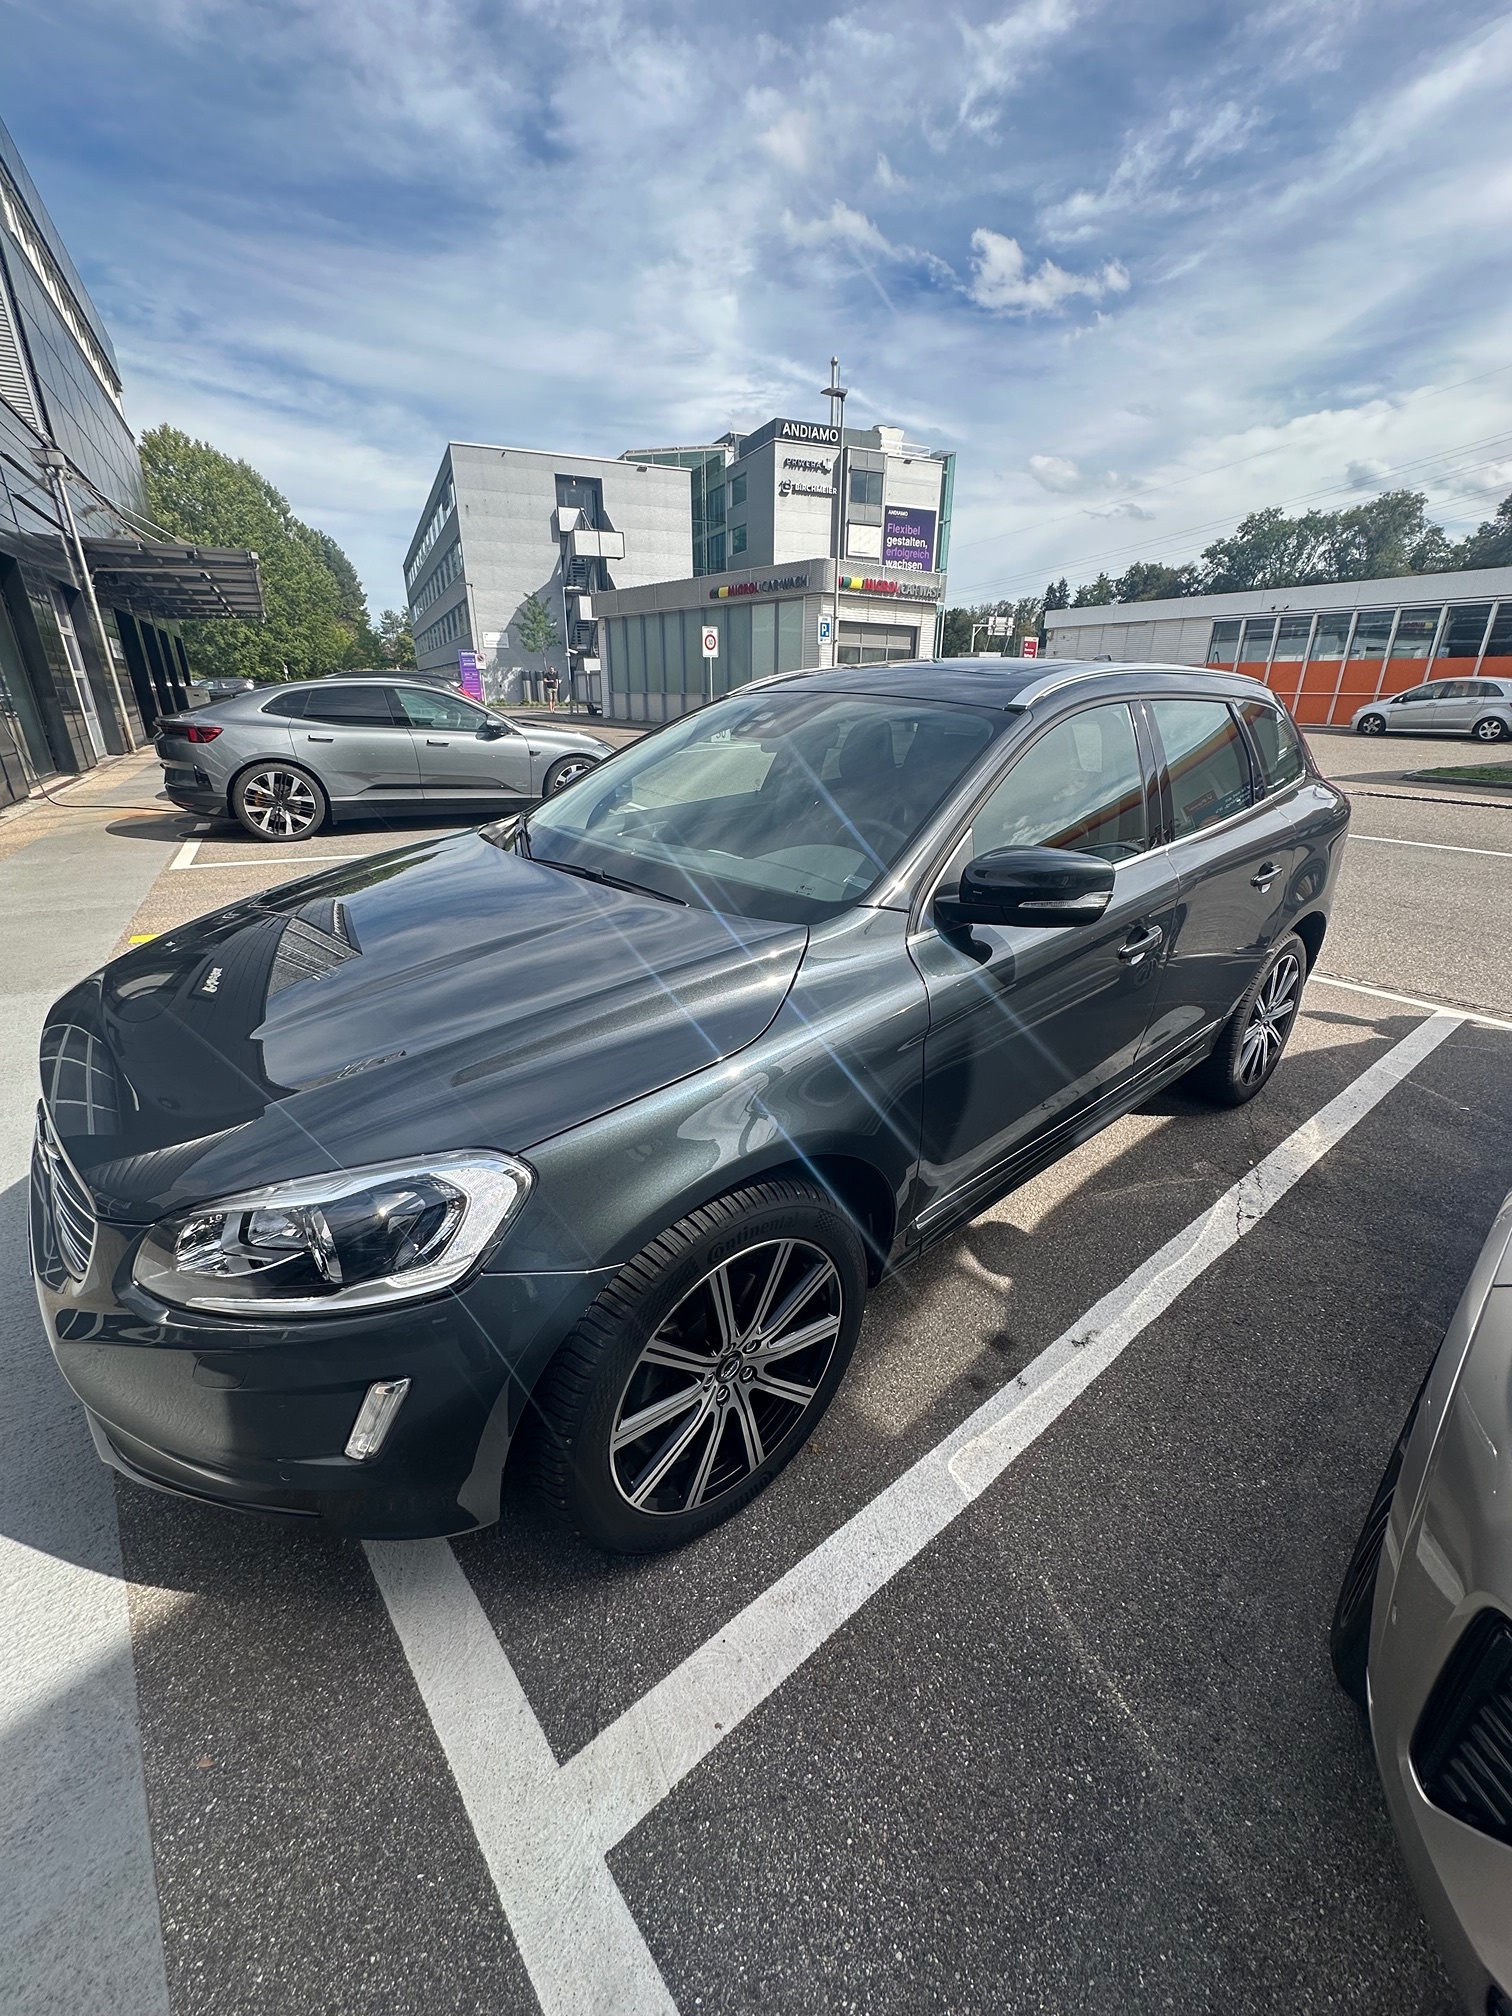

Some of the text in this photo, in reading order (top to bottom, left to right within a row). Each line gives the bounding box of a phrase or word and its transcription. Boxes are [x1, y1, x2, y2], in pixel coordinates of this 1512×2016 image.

[782, 422, 839, 442] ANDIAMO
[795, 482, 838, 495] BIRCHMEIER
[887, 522, 921, 536] Flexibel
[886, 536, 928, 550] gestalten,
[885, 547, 930, 560] erfolgreich
[885, 559, 923, 570] wachsen
[728, 582, 759, 598] MIGROL
[864, 578, 899, 593] MIGROL
[901, 582, 919, 595] CAR
[707, 1212, 799, 1265] Continental
